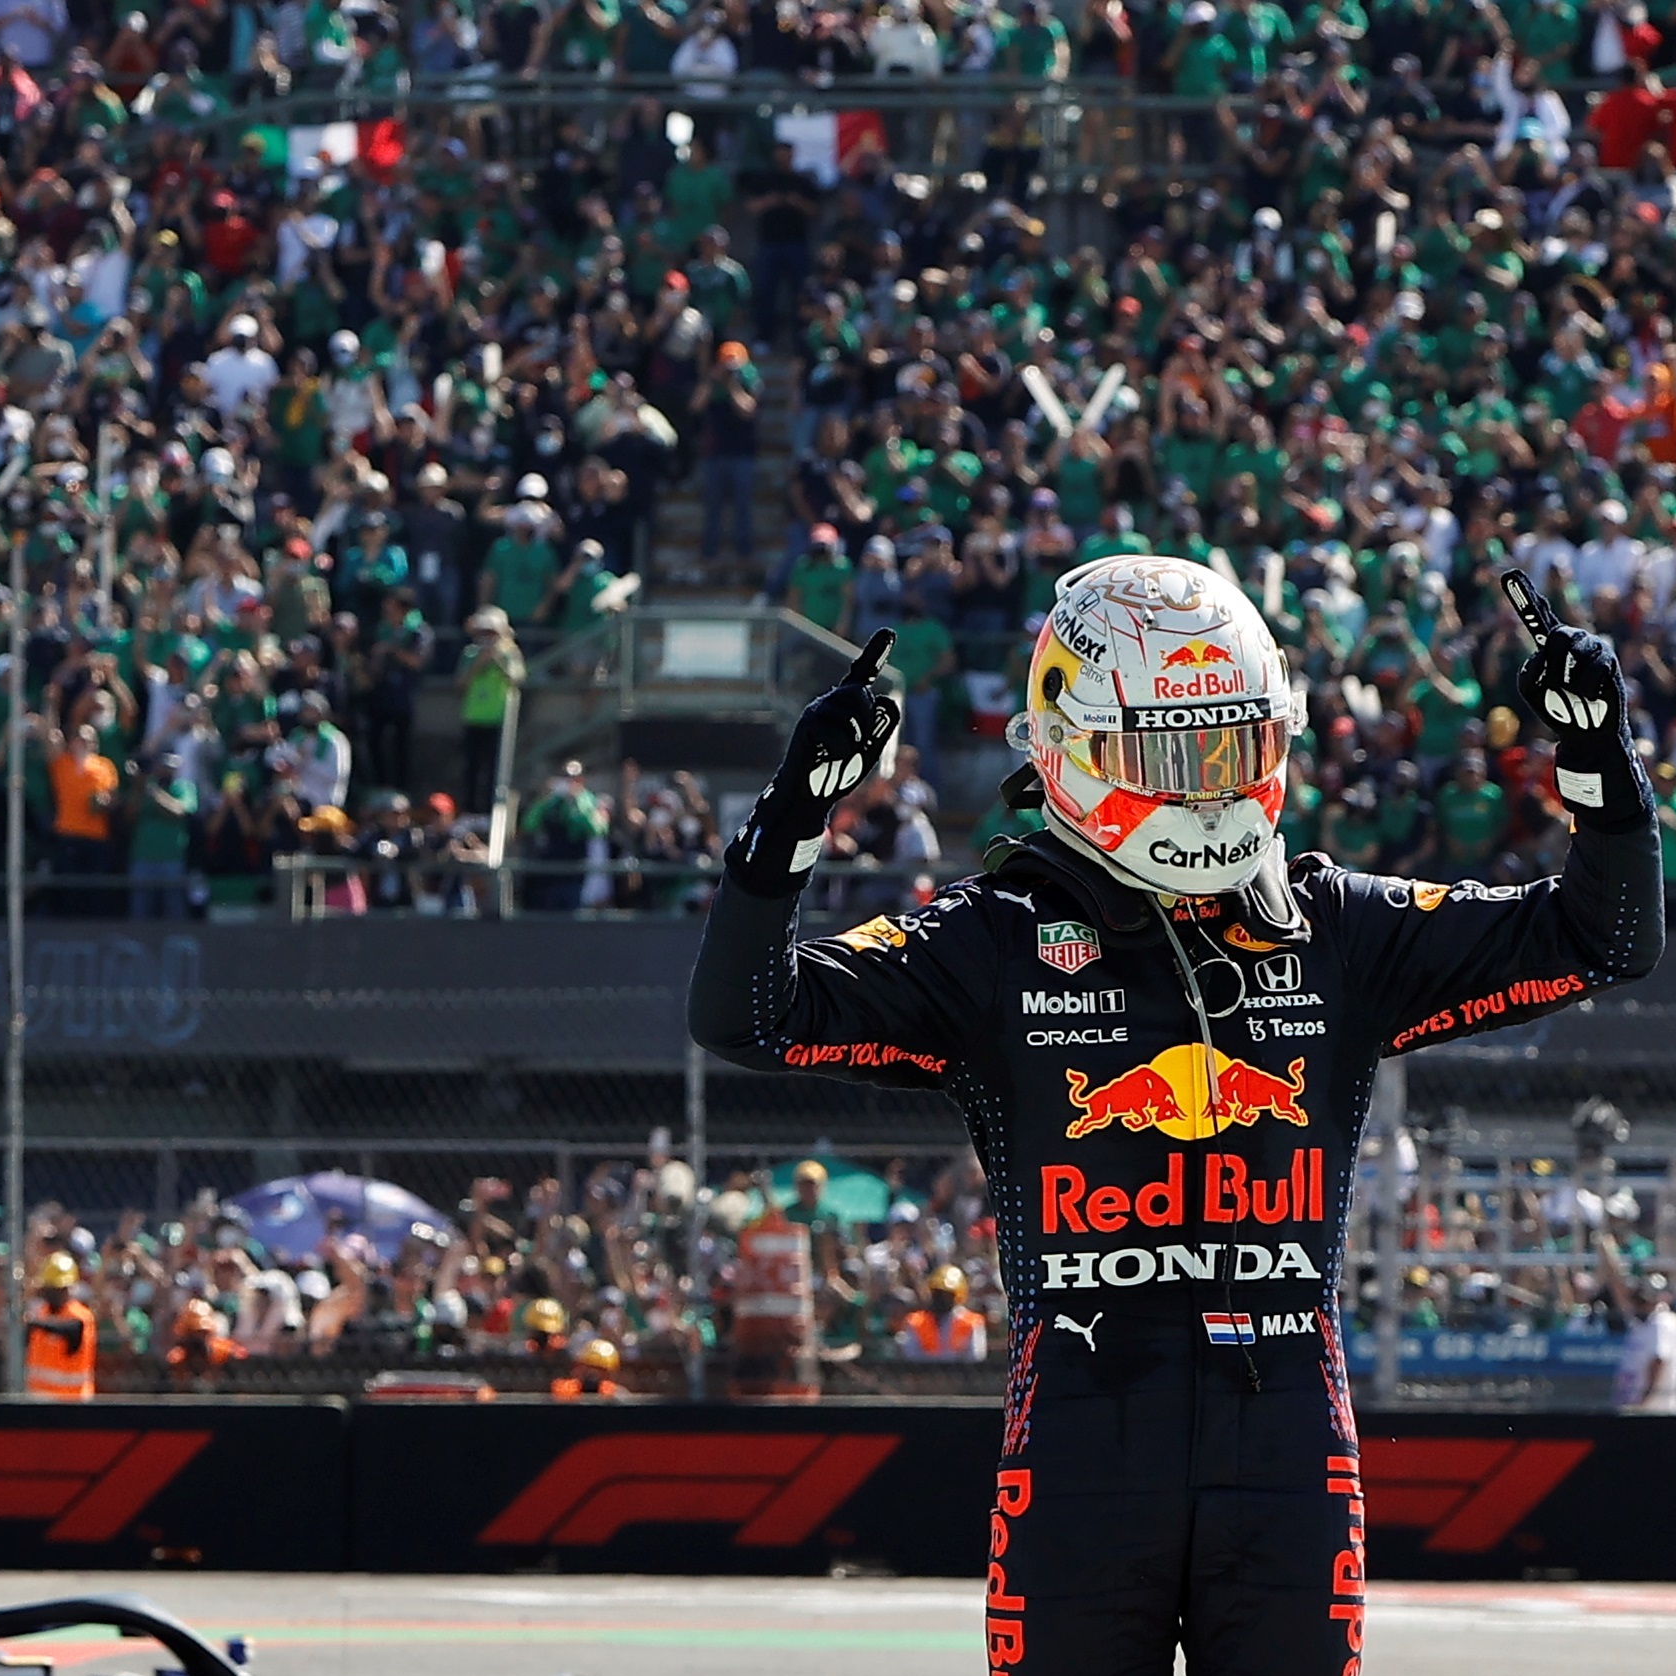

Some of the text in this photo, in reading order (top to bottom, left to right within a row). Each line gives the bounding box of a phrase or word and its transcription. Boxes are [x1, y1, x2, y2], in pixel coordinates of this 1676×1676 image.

[1054, 606, 1107, 664] arNext
[1154, 668, 1245, 699] Red Bull
[1083, 713, 1107, 723] Mobil
[1135, 701, 1264, 728] HONDA
[1148, 834, 1261, 869] CarNext
[1042, 923, 1096, 944] TAG
[1040, 944, 1099, 972] HEUER
[1022, 990, 1096, 1015] Mobil
[1243, 992, 1324, 1010] HONDA
[1460, 993, 1506, 1025] YOU
[1508, 973, 1586, 1006] WINGS
[1026, 1026, 1129, 1046] ORACLE
[1269, 1018, 1326, 1038] Tezos
[1041, 1147, 1324, 1235] Red Bull
[1040, 1242, 1322, 1290] HONDA
[1261, 1311, 1317, 1337] MAX
